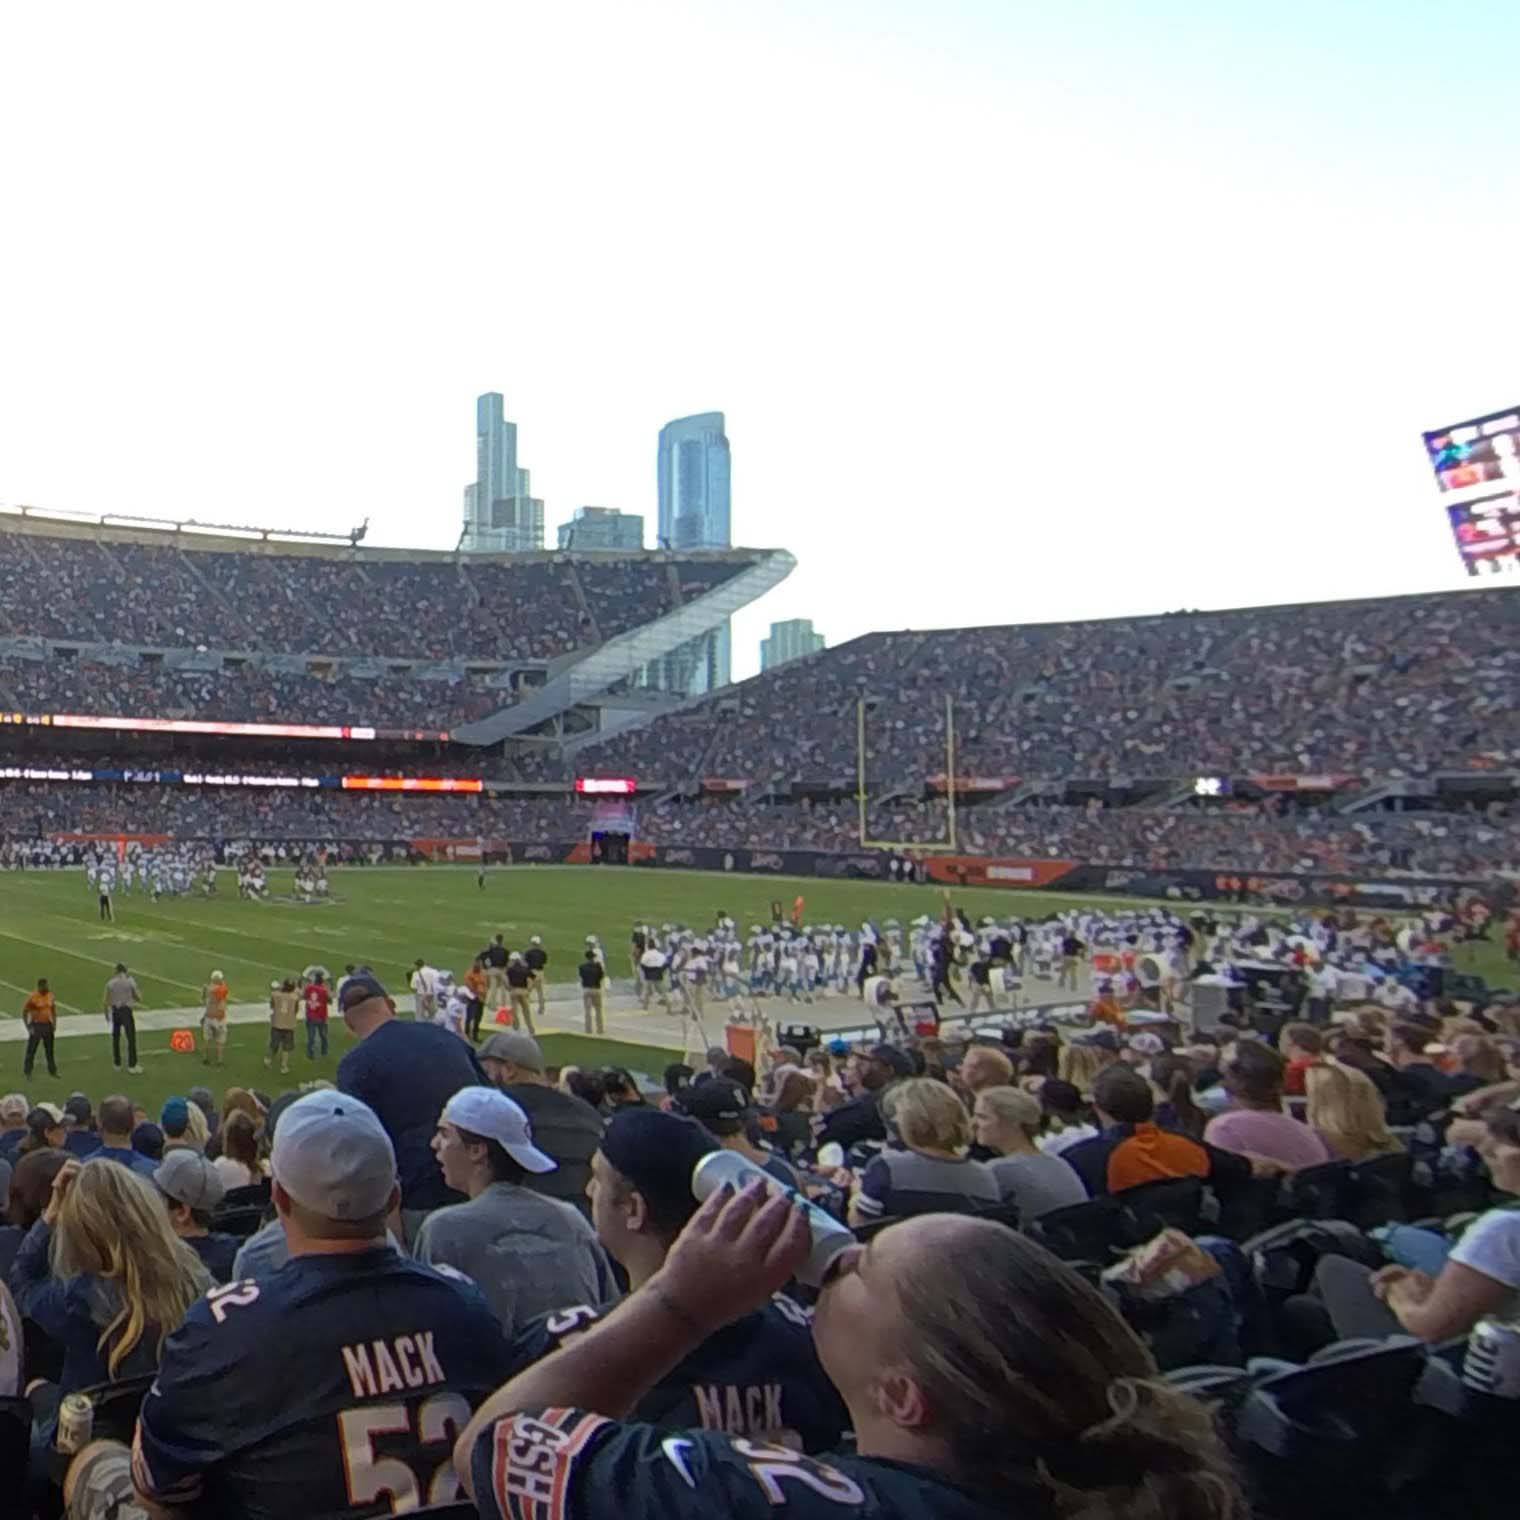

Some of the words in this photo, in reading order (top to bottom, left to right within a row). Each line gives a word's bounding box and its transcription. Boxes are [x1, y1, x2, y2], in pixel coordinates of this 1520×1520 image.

[340, 1330, 447, 1399] MACK
[692, 1383, 784, 1433] MACK
[335, 1390, 474, 1516] 52
